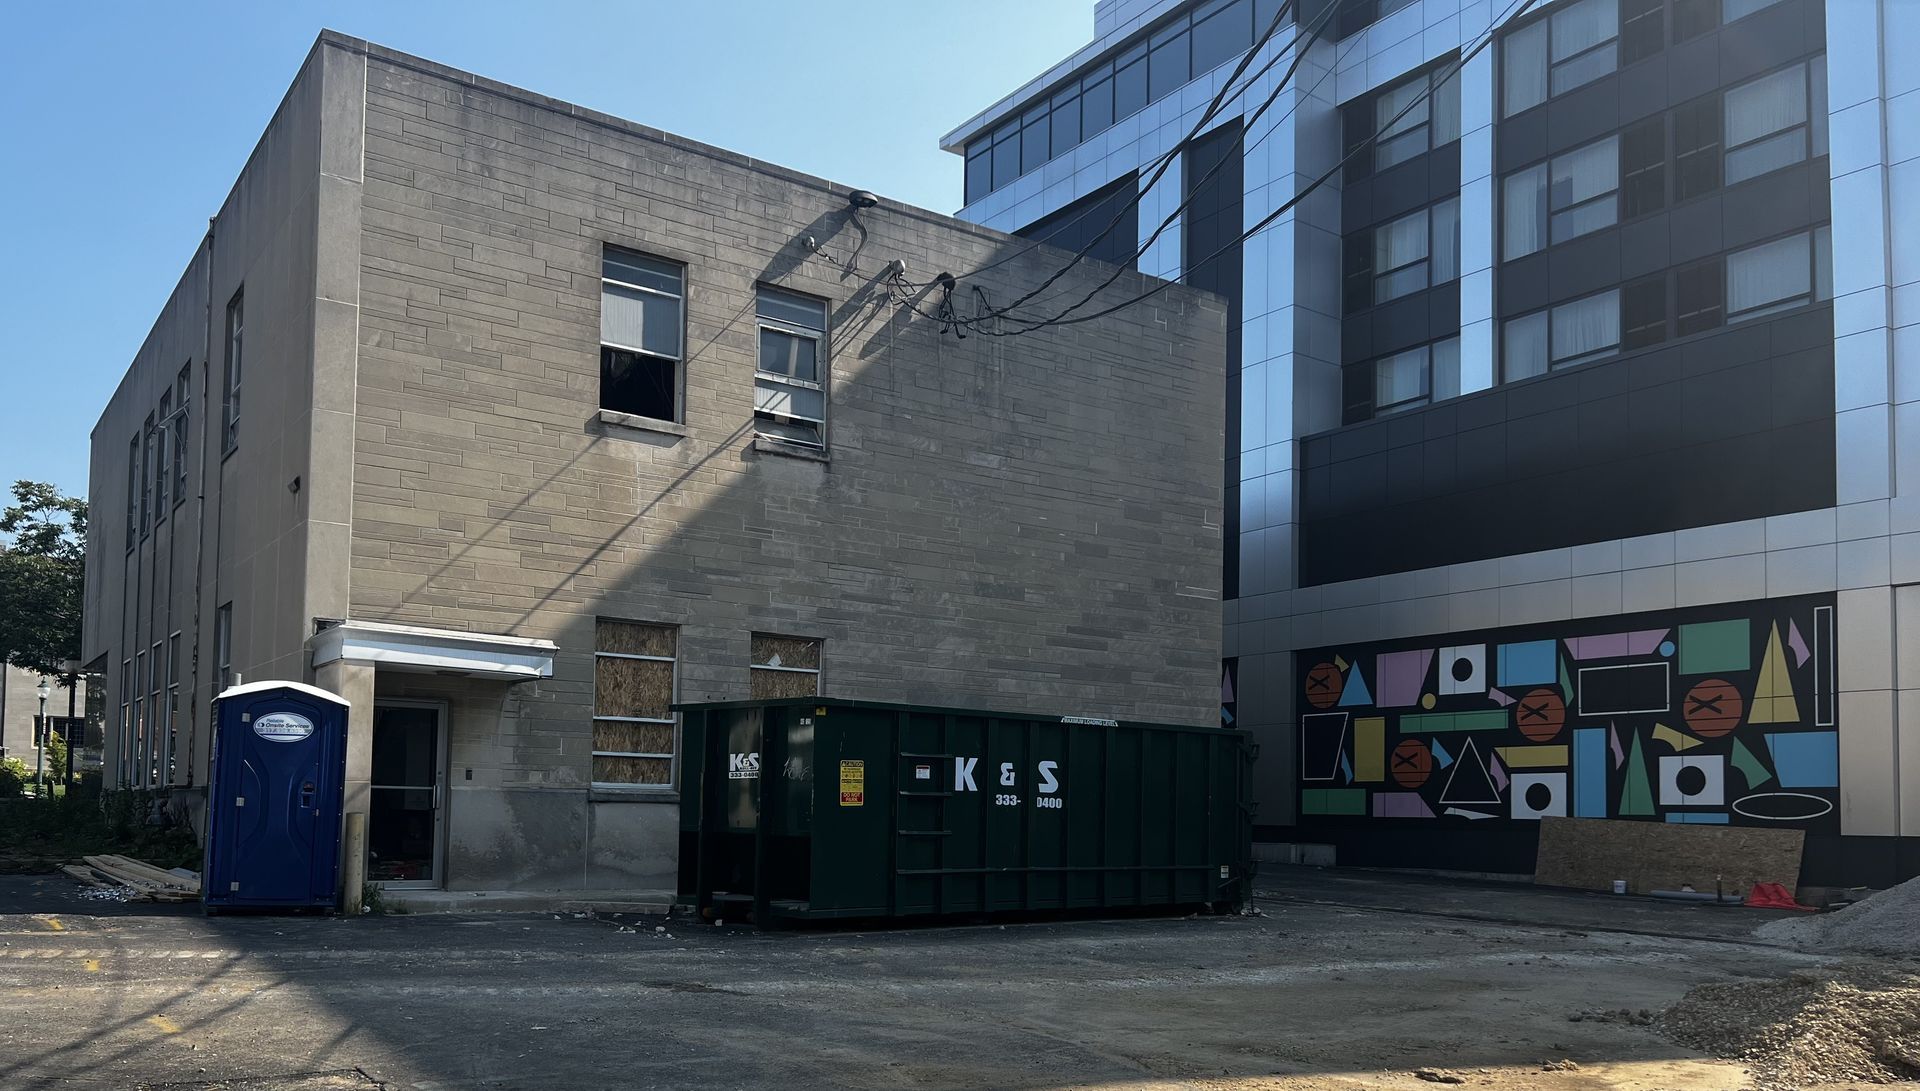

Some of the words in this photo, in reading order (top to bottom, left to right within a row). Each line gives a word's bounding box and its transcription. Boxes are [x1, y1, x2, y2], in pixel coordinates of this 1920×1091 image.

[729, 752, 760, 771] K&S
[955, 757, 978, 791] K
[1000, 762, 1015, 786] &
[1038, 761, 1059, 793] S
[1037, 797, 1062, 809] 0400
